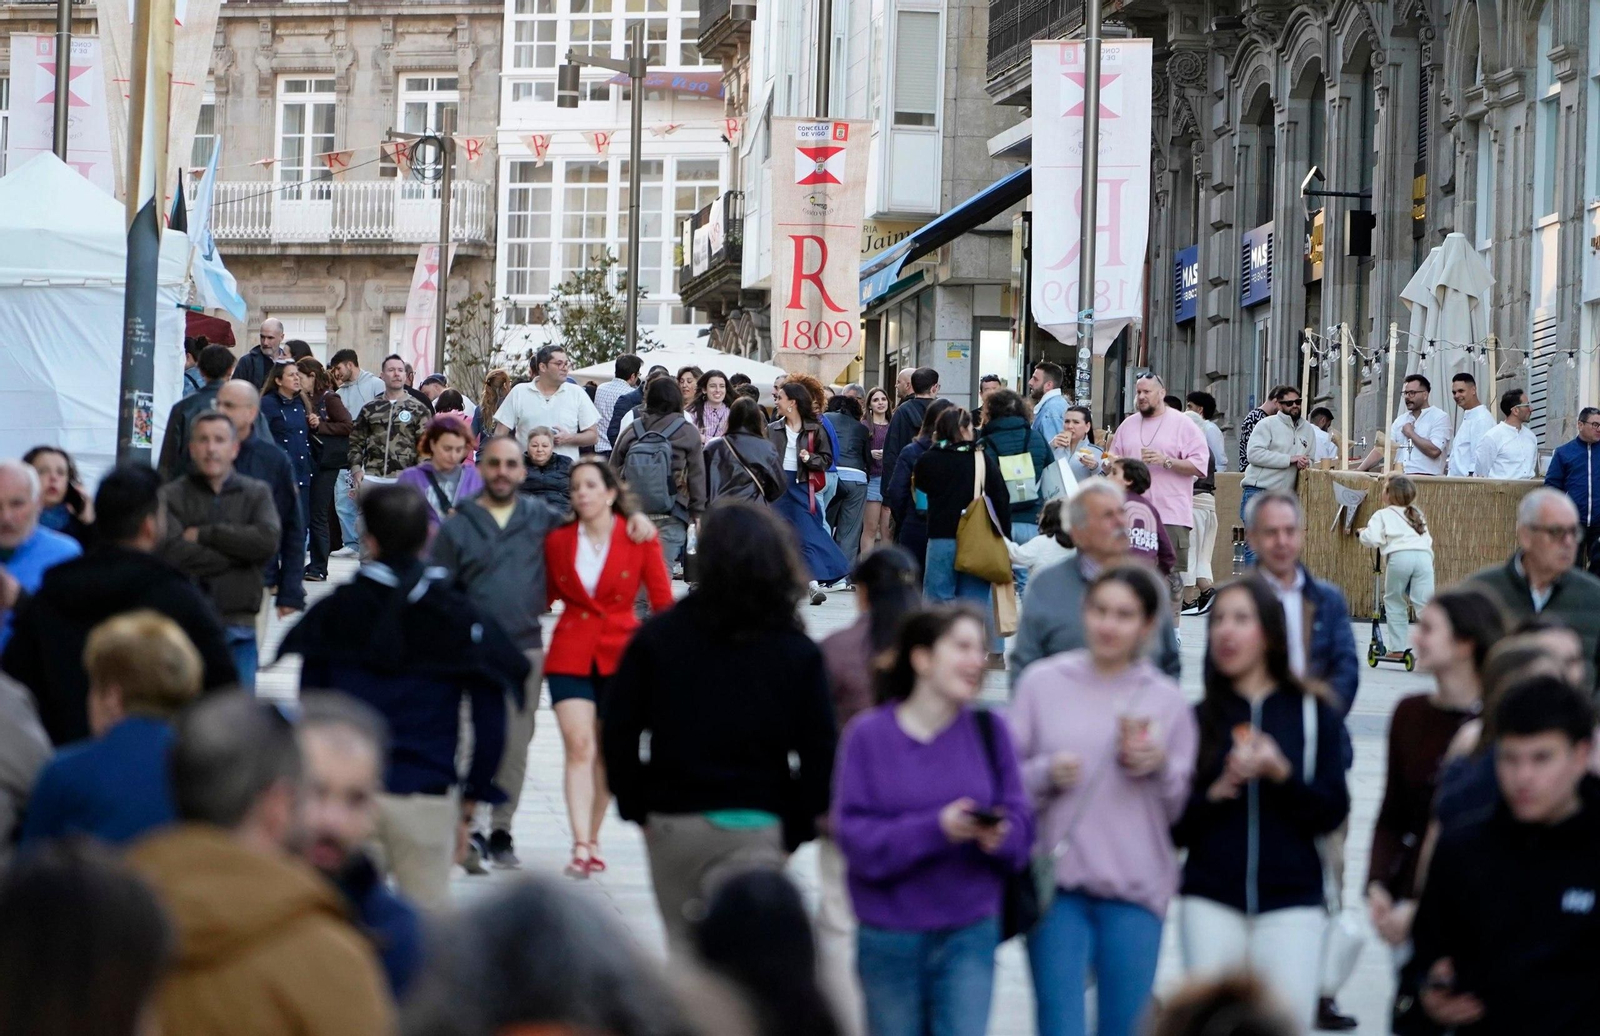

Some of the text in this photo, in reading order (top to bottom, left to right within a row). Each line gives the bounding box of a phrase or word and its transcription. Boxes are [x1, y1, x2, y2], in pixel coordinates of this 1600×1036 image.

[861, 226, 921, 254] Jaim
[785, 234, 849, 313] R
[780, 319, 853, 351] 1809
